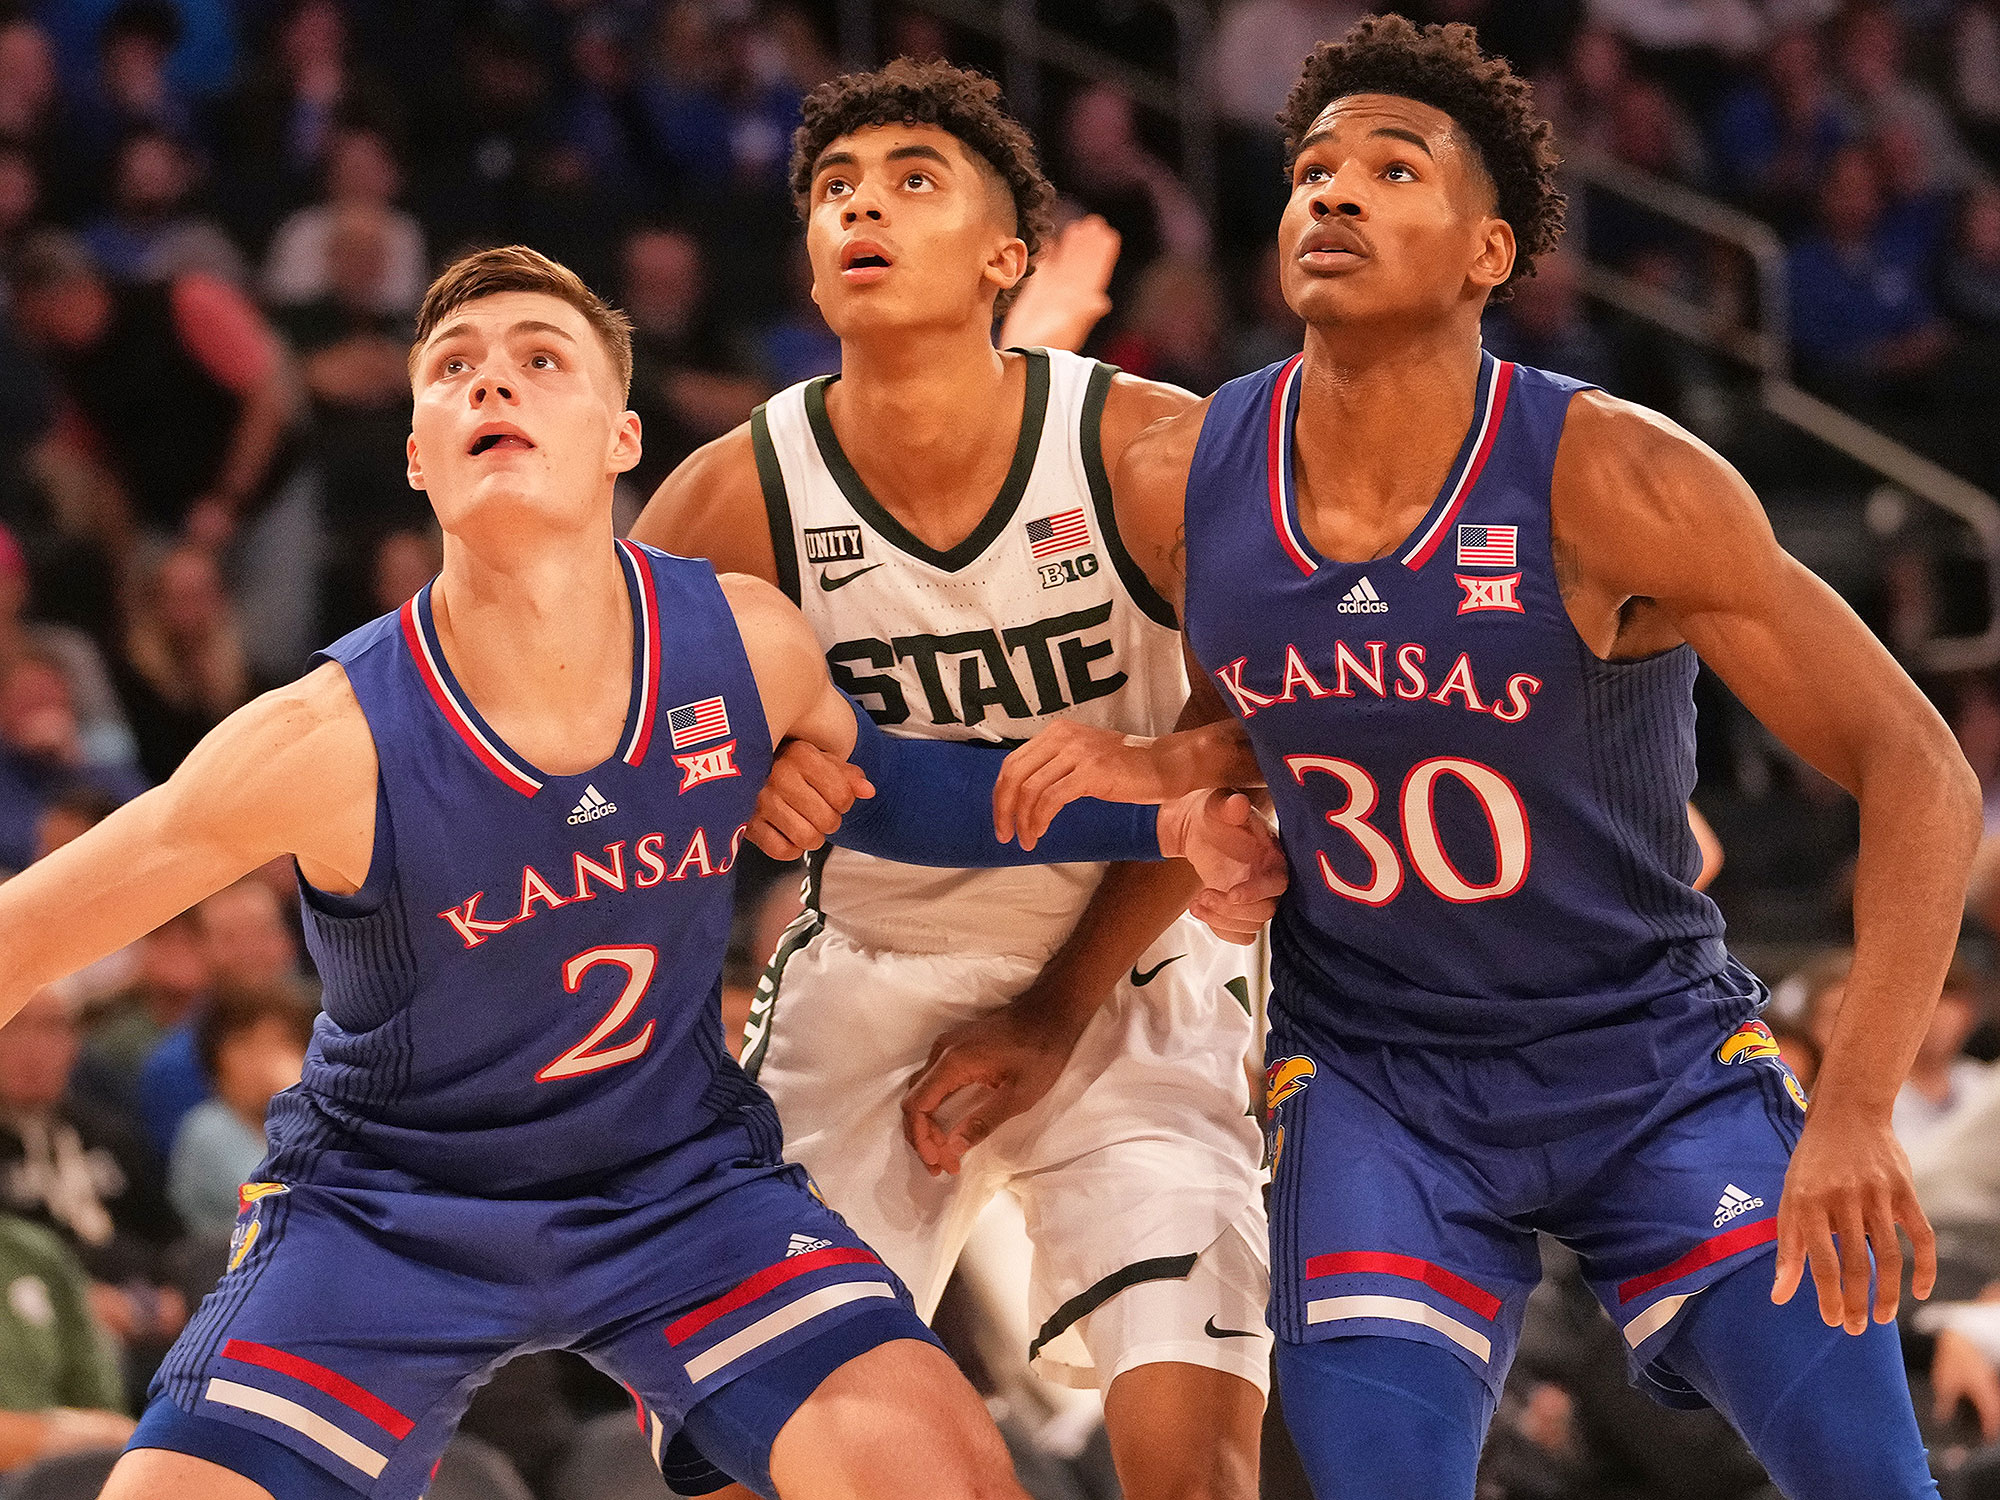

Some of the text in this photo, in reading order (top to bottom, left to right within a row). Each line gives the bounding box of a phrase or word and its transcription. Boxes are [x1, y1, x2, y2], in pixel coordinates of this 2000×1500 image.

[806, 529, 862, 560] UNITY
[1337, 598, 1389, 614] adidas
[1457, 573, 1524, 614] XII
[826, 599, 1129, 727] STATE
[1215, 640, 1543, 723] KANSAS
[675, 742, 740, 792] XII
[566, 801, 617, 826] adidas
[1283, 753, 1532, 908] 30
[437, 822, 748, 948] KANSAS
[534, 943, 659, 1084] 2
[1712, 1197, 1764, 1229] adidas
